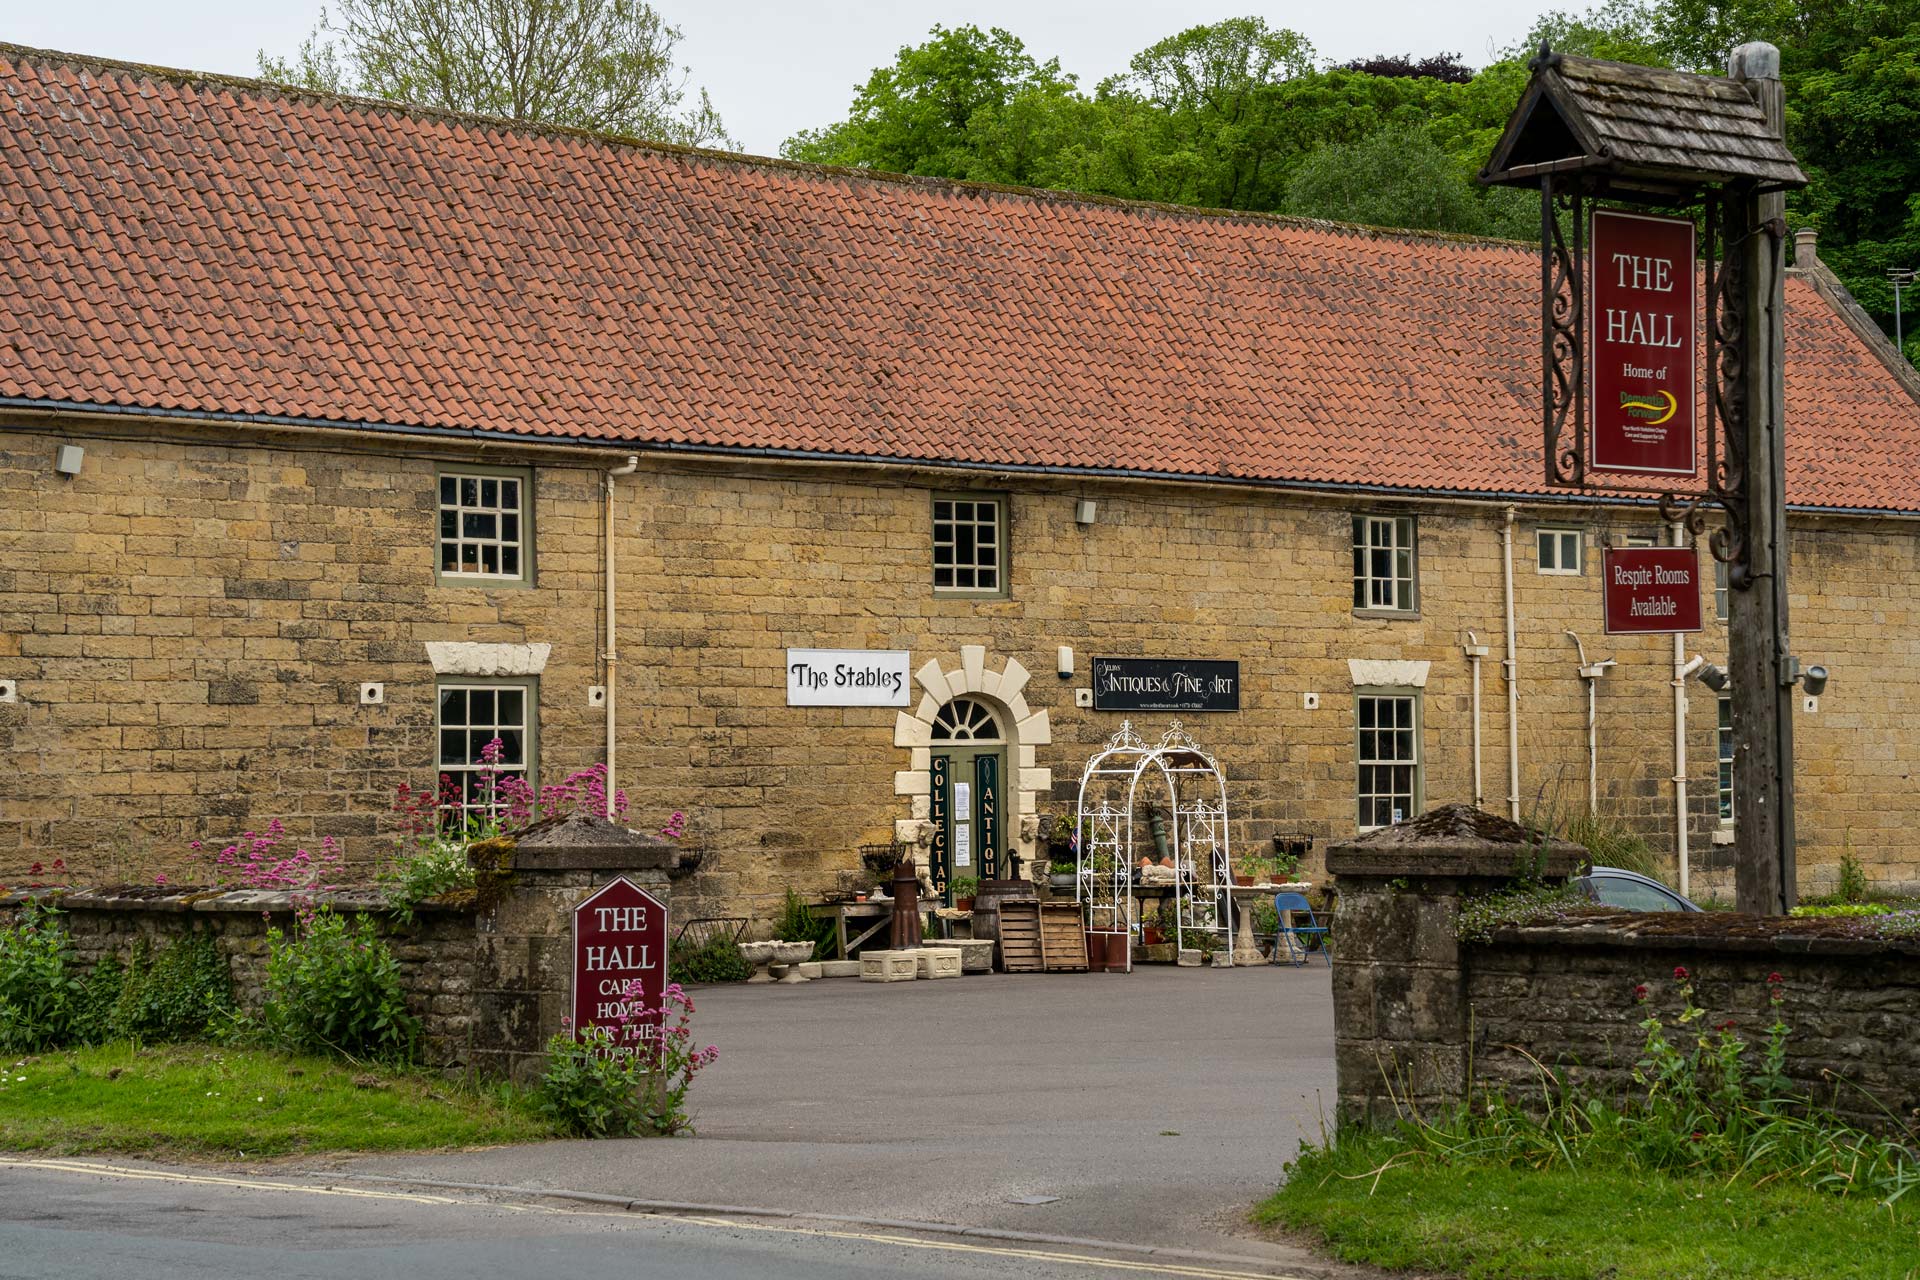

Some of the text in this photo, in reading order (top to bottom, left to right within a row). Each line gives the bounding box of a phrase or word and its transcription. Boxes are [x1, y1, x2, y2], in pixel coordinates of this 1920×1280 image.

[1612, 253, 1673, 292] THE
[1606, 308, 1682, 348] HALL
[1623, 363, 1668, 380] Home of
[1620, 391, 1665, 406] Dementia
[1628, 406, 1662, 419] Forward
[1614, 565, 1690, 590] Respite Rooms
[1630, 596, 1677, 616] Available
[791, 664, 903, 699] The Stables
[1097, 673, 1161, 696] ANTIQUES
[1169, 672, 1203, 698] FINE
[1202, 674, 1233, 698] ART
[934, 759, 946, 898] COLLECTAB
[983, 787, 995, 880] ANTIQU
[595, 907, 647, 932] THE
[585, 945, 656, 971] HALL
[586, 1023, 656, 1041] OR THE
